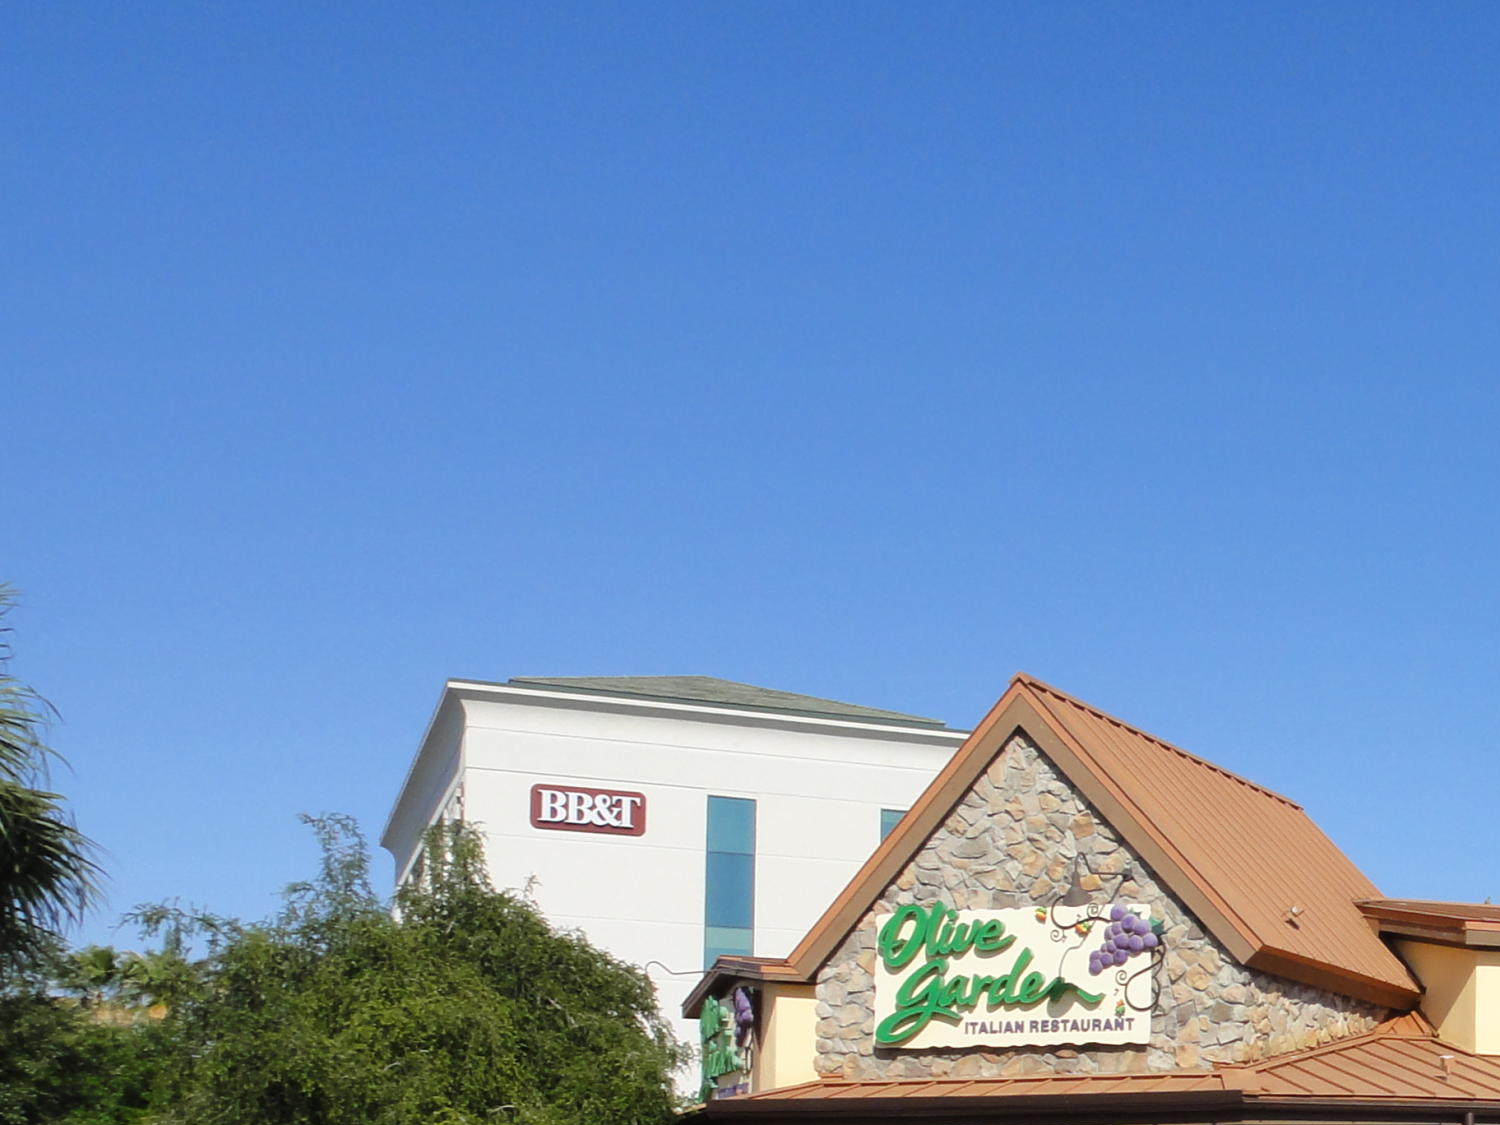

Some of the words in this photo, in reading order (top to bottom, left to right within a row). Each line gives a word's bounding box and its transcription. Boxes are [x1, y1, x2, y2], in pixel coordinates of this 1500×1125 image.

[537, 789, 641, 829] BB&T
[877, 901, 1017, 968] Olive
[876, 947, 1105, 1044] Garden
[964, 1019, 1025, 1035] ITALIAN
[1029, 1017, 1135, 1033] RESTAURANT
